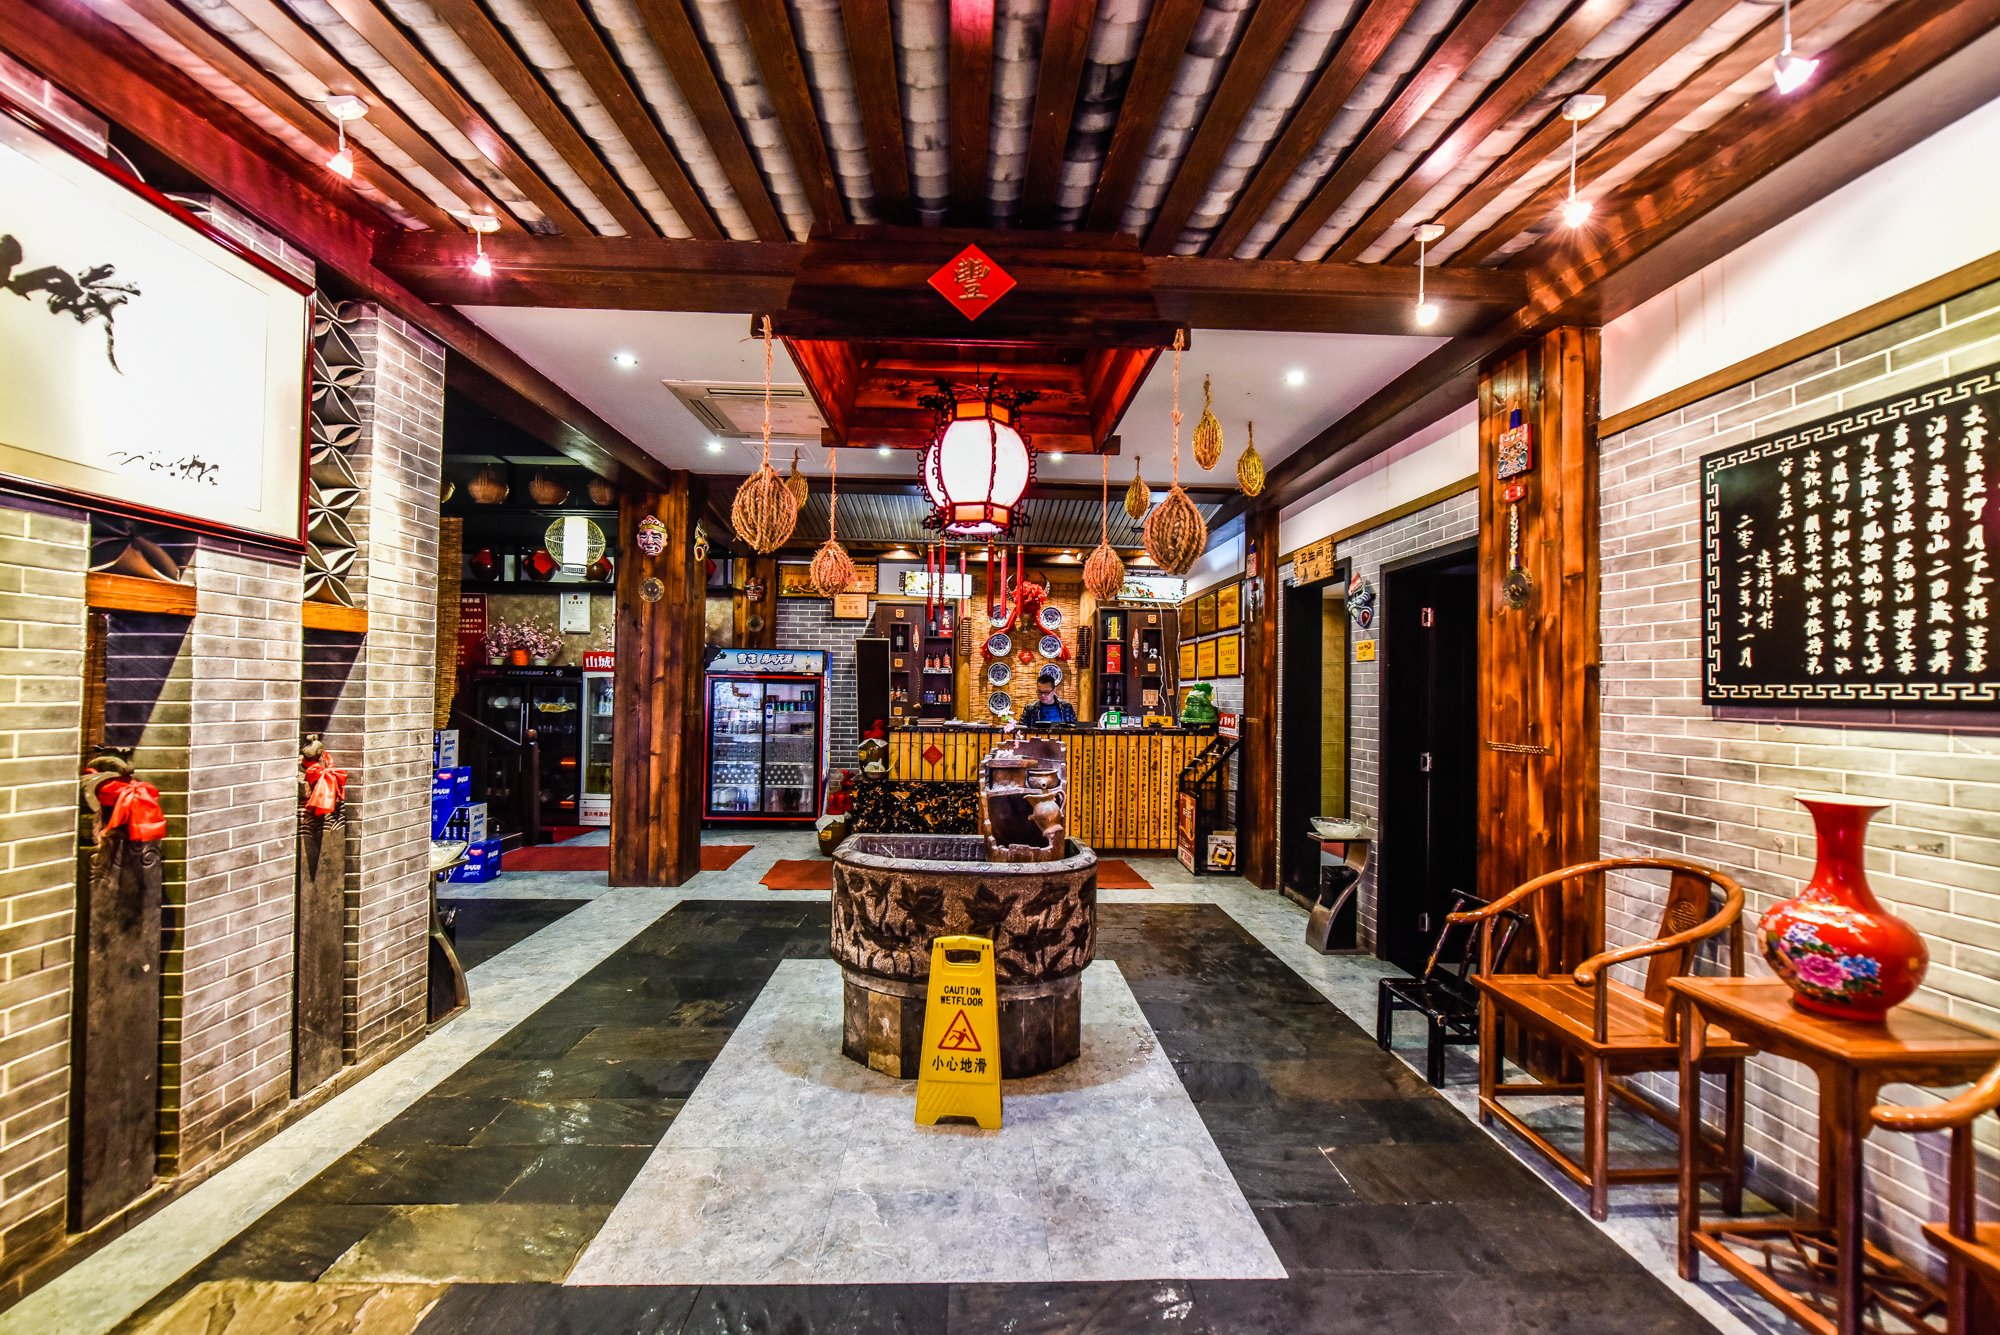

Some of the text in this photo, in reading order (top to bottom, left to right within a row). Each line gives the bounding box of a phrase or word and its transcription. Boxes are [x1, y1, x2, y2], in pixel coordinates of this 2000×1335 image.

[1299, 546, 1324, 565] 卫生间
[1736, 514, 1755, 668] 二零一三年十一月
[736, 653, 794, 665] 雪花 勇闯天涯
[943, 985, 981, 996] CAUTION
[931, 1055, 988, 1074] 小心地滑
